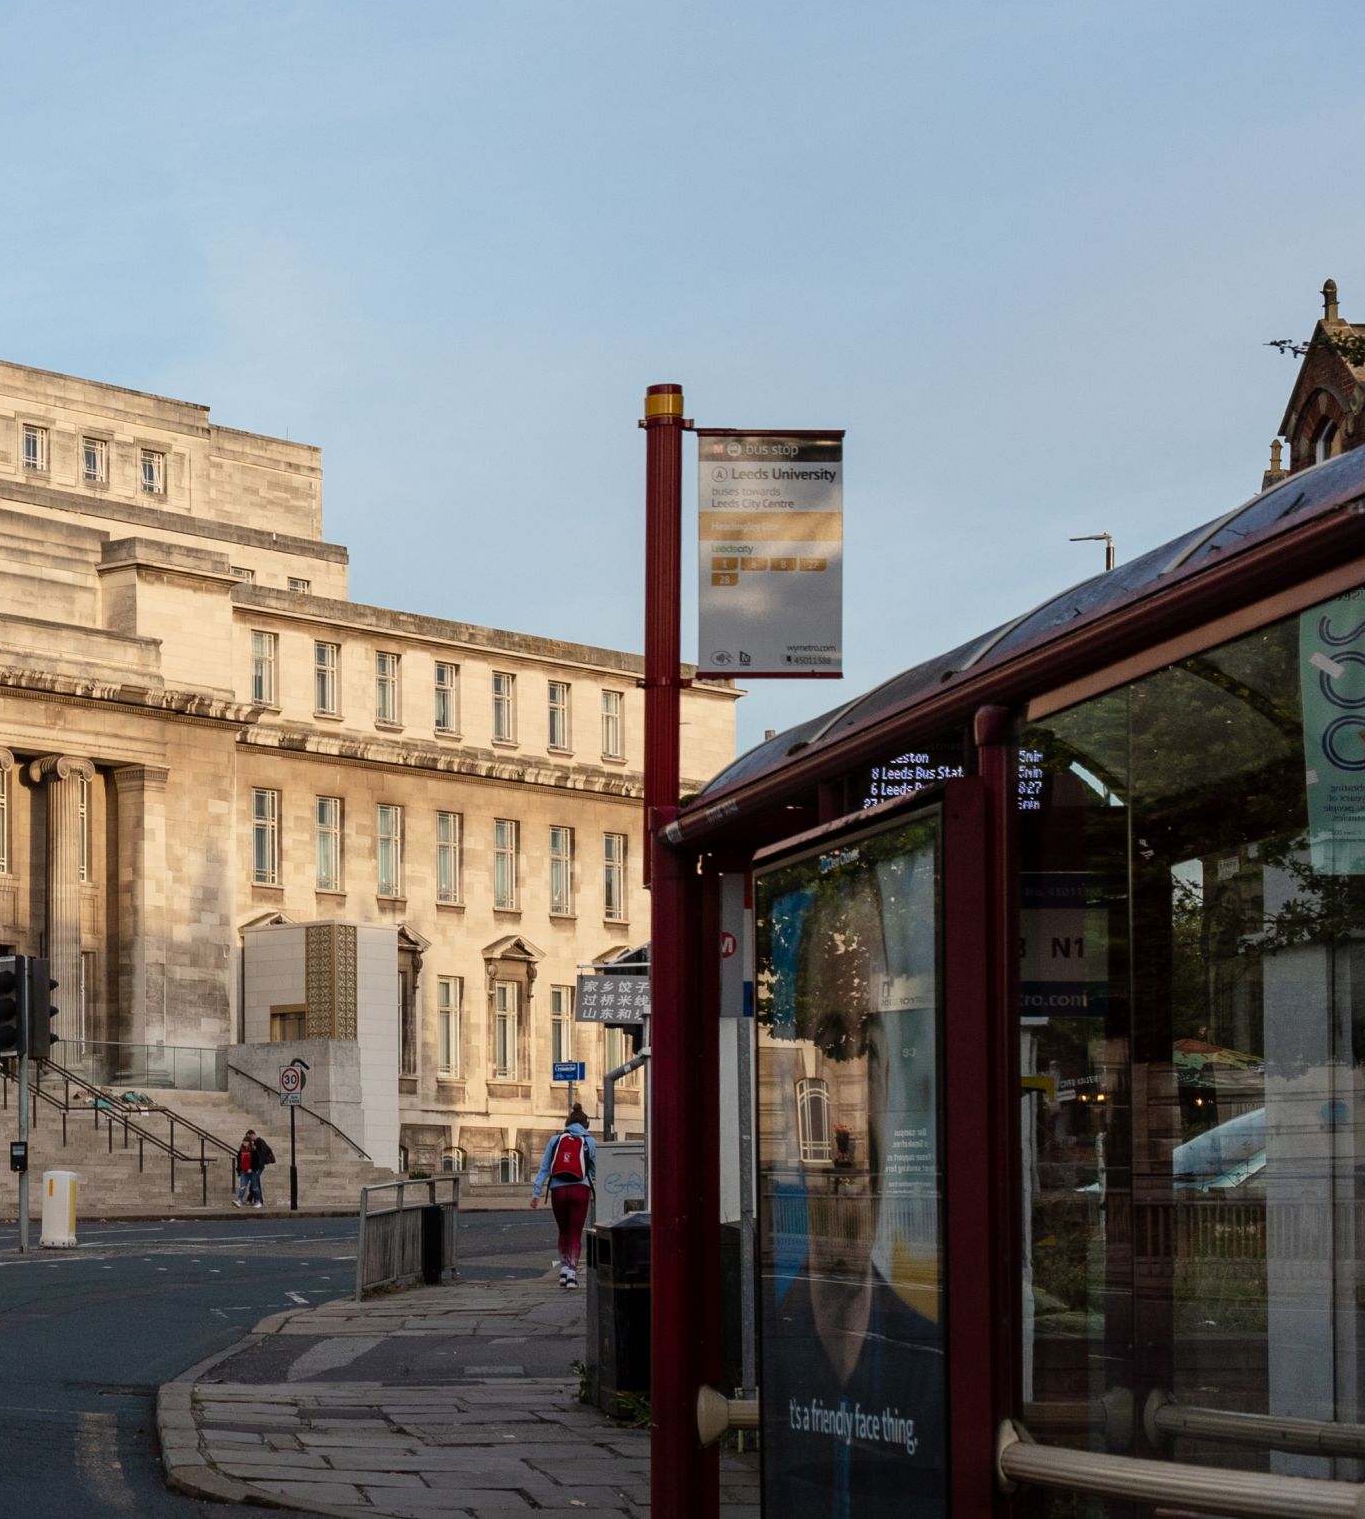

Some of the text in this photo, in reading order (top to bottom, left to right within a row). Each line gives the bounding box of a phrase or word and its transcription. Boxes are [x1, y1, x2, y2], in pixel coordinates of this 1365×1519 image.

[746, 443, 768, 456] bus
[772, 444, 799, 458] stop
[731, 468, 769, 480] Leeds
[772, 468, 837, 483] University
[712, 487, 781, 496] buses towards
[712, 499, 795, 510] Leeds City Centre
[787, 644, 837, 653] wymetro.com
[872, 767, 879, 780] 8
[882, 767, 913, 780] Leeds
[916, 766, 936, 780] Bus
[870, 782, 878, 795] 6
[1052, 937, 1084, 959] N1
[582, 980, 650, 993] 家乡饺子
[284, 1074, 297, 1085] 30
[803, 1406, 810, 1432] a
[811, 1397, 854, 1446] friendly
[854, 1402, 881, 1441] face
[881, 1406, 919, 1456] thing.
